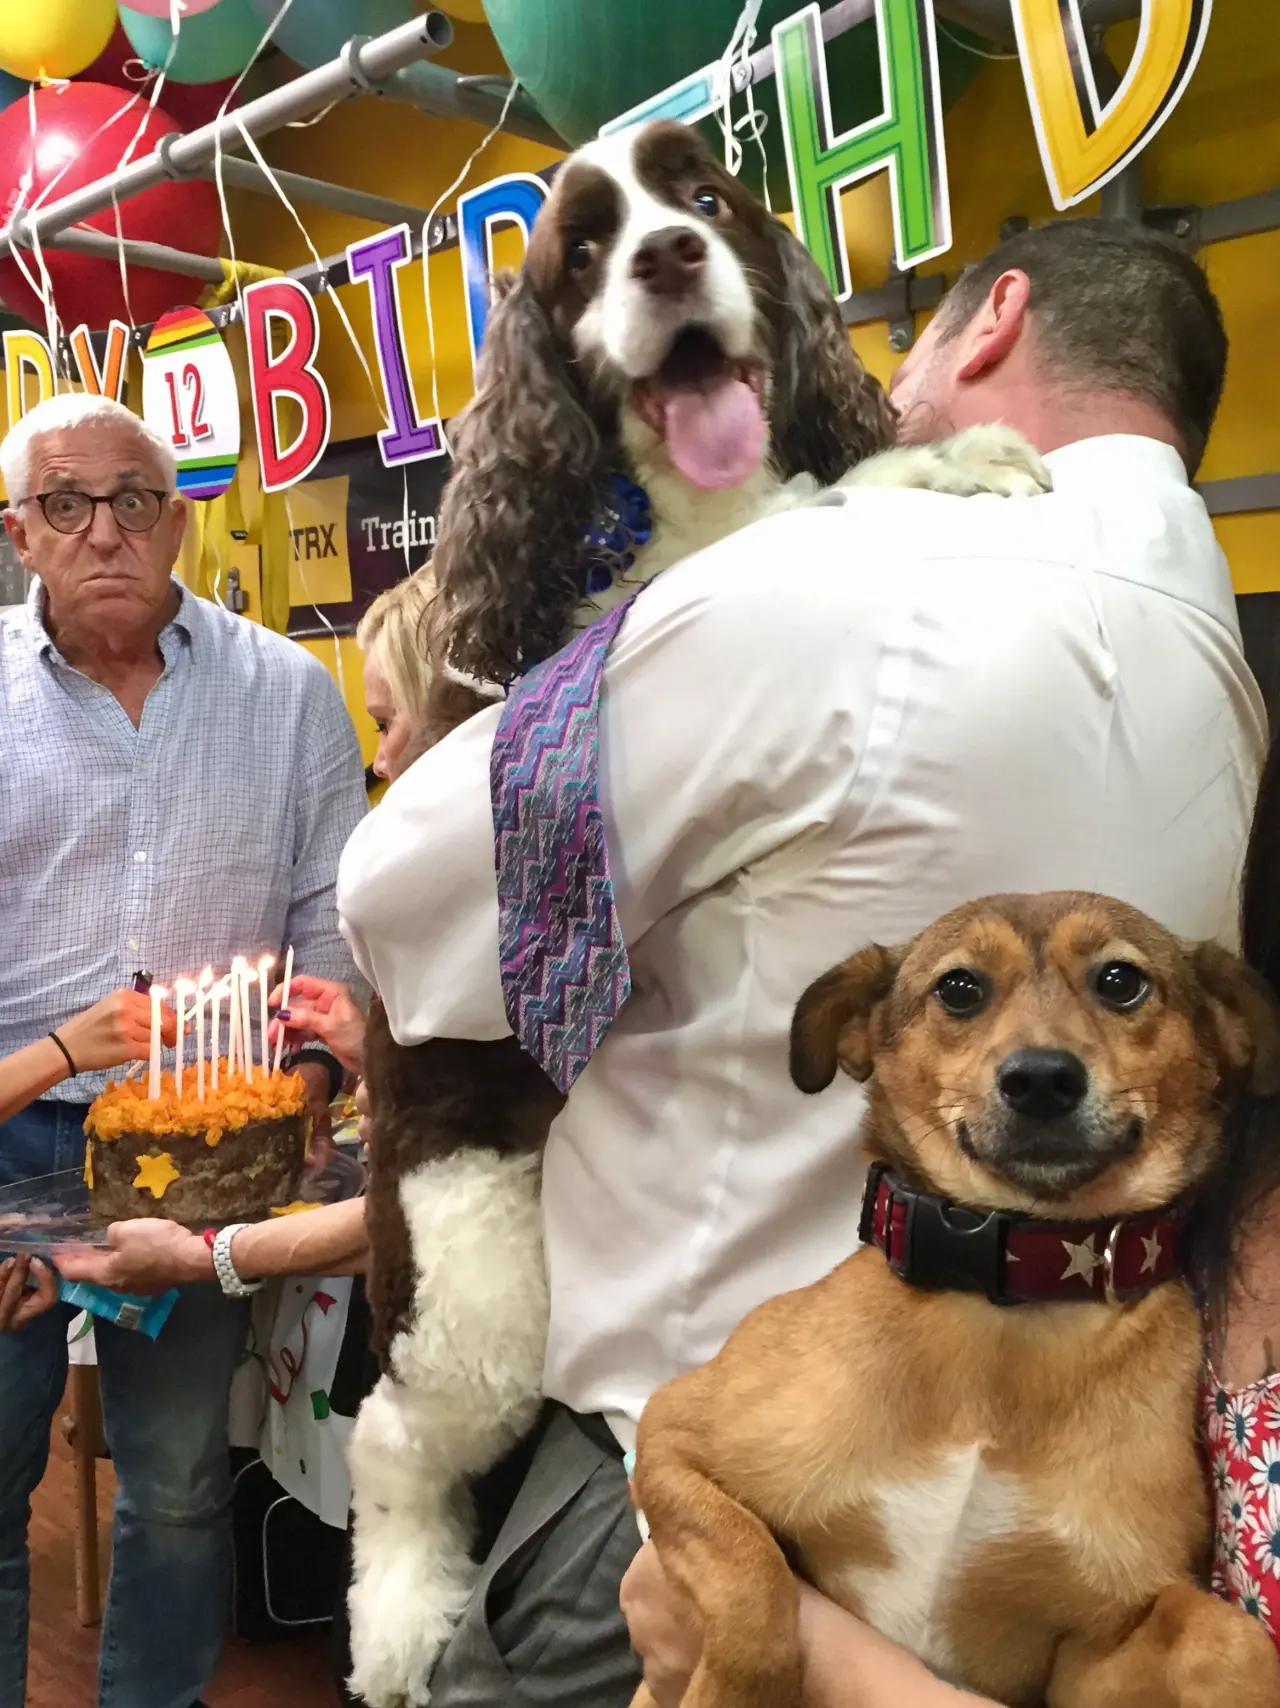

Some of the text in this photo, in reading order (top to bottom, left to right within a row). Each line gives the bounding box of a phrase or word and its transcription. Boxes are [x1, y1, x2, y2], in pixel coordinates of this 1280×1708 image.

[164, 362, 214, 448] 12
[288, 510, 437, 561] TRX Train
